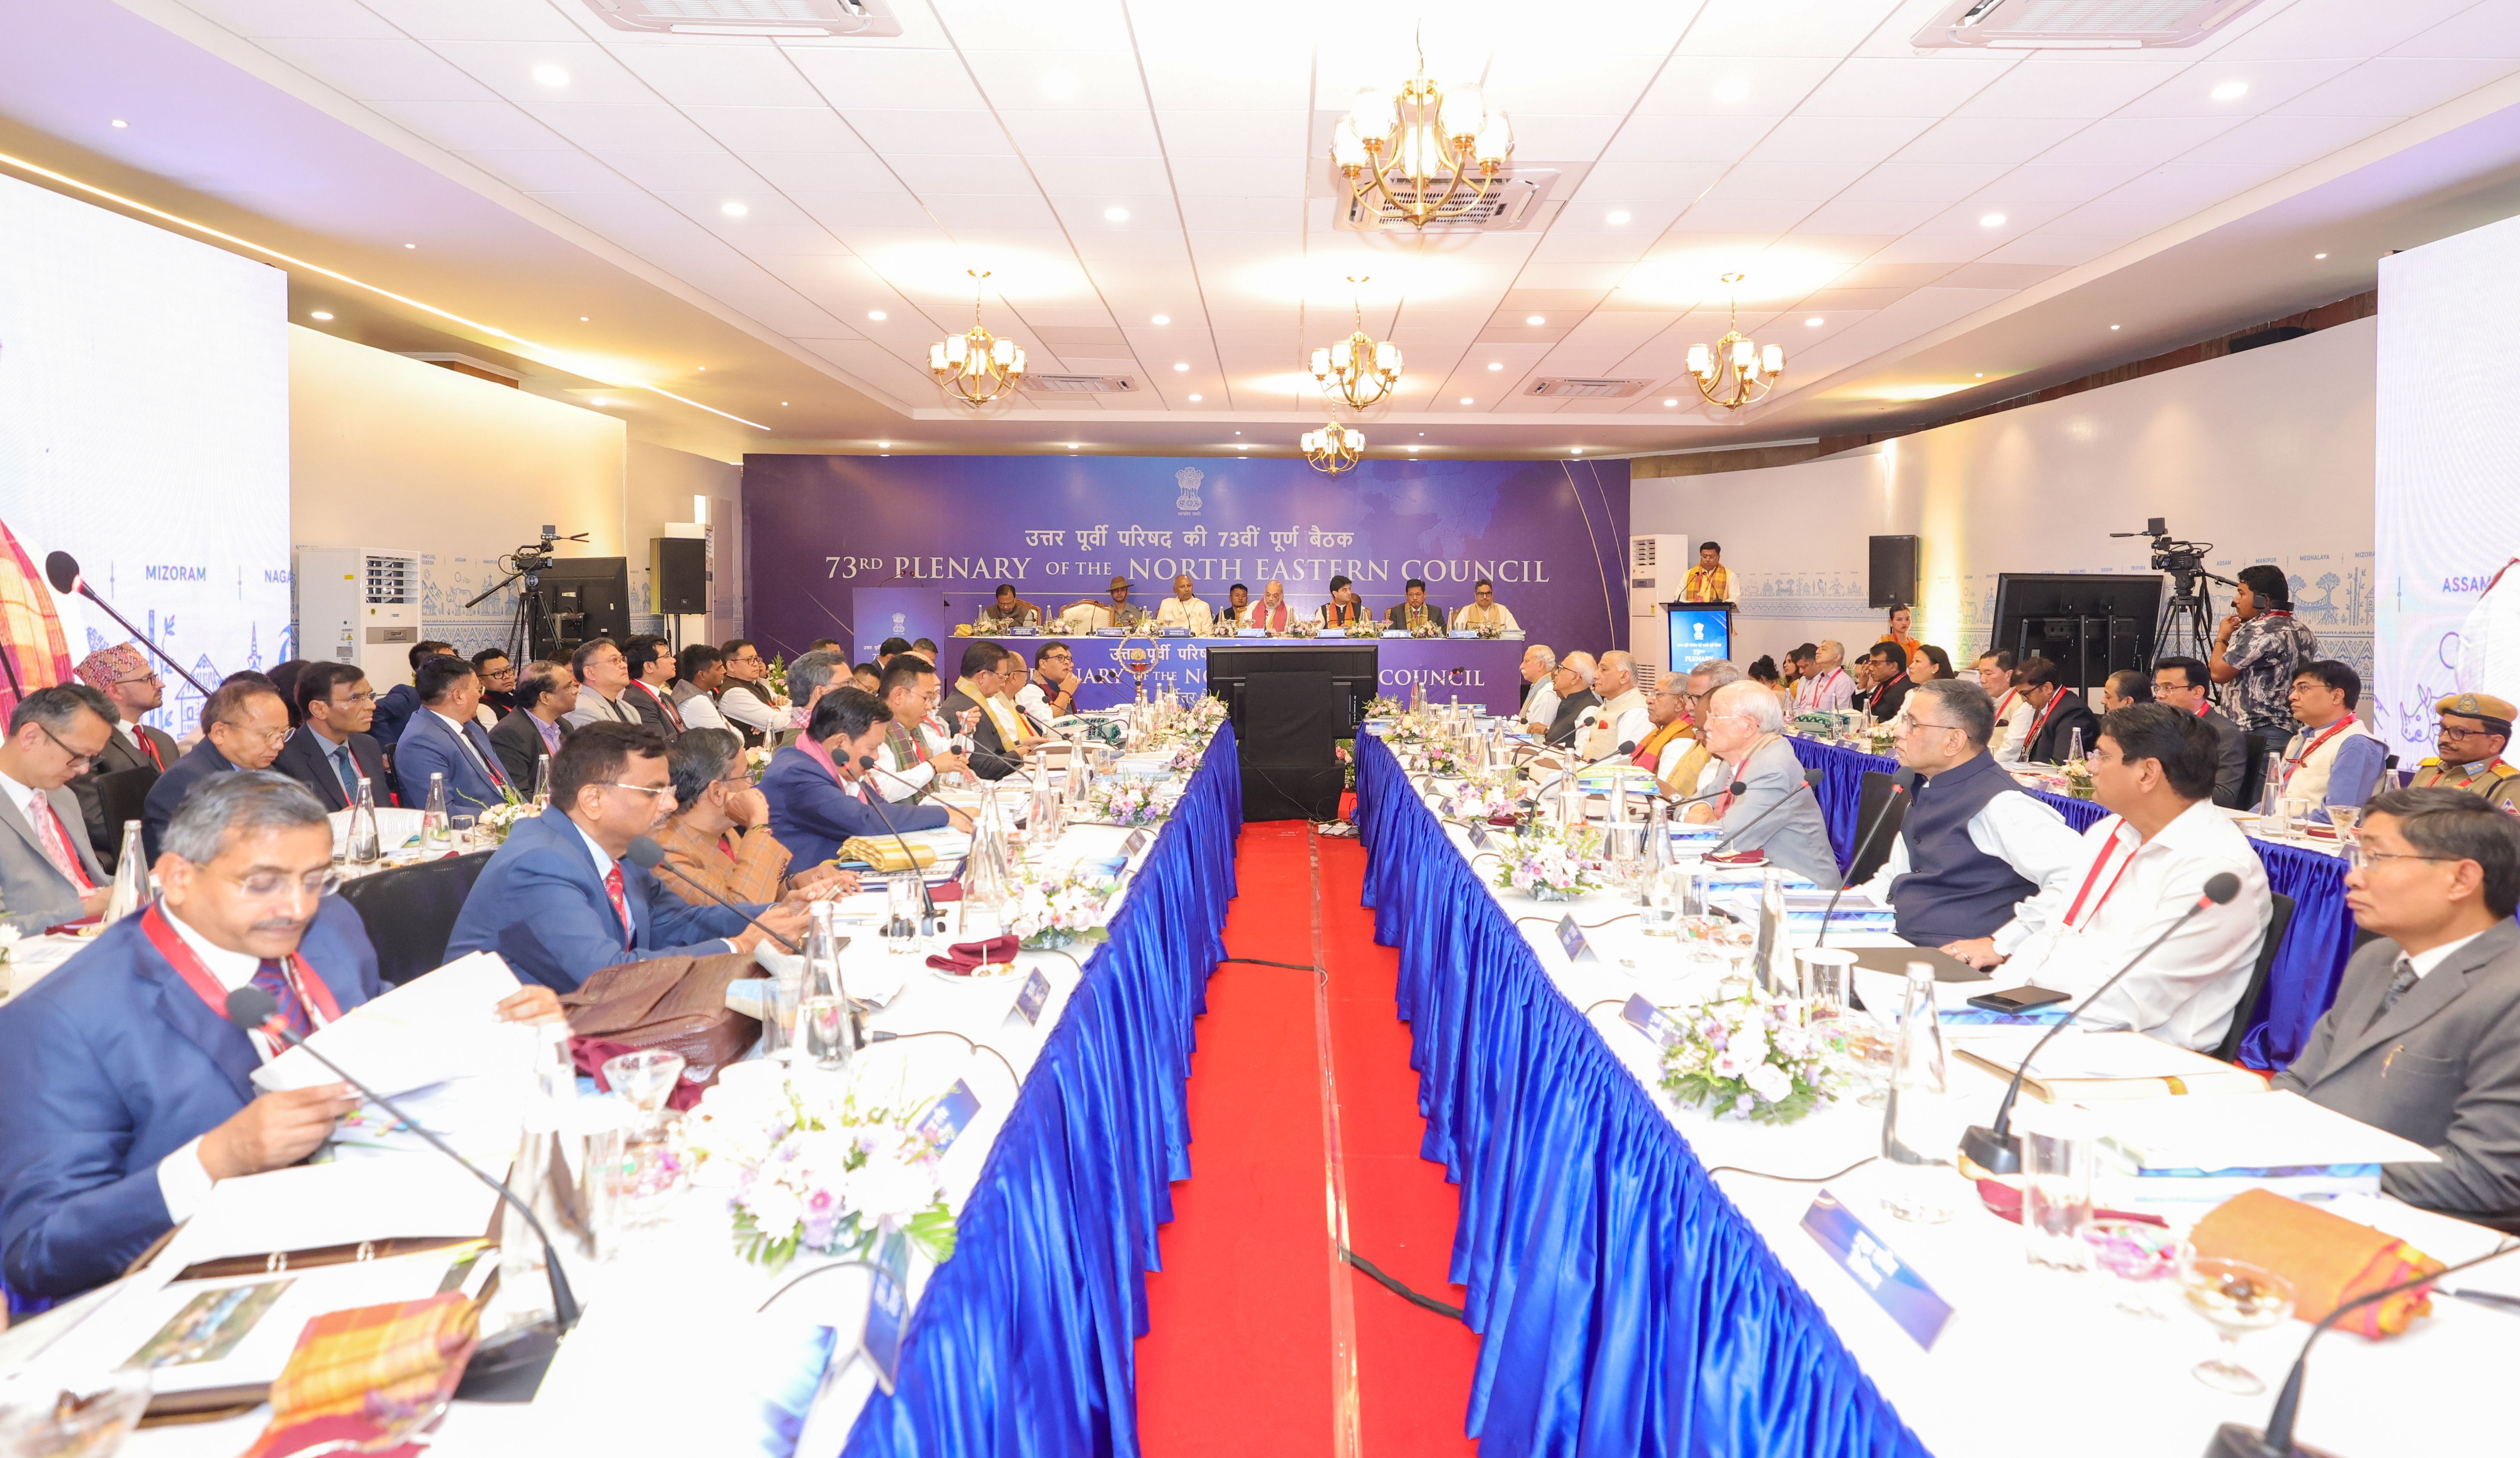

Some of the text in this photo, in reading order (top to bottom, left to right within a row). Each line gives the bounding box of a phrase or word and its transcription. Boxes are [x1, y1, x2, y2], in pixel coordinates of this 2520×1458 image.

[1025, 524, 1354, 552] उत्तर पूर्वी परिषद की 73वीं पूर्ण बैठक
[146, 565, 206, 581] MIZORAM
[826, 556, 1549, 582] 73RD PLENARY OF THE NORTH EASTERN COUNCIL
[2442, 575, 2492, 593] ASSAM
[1177, 644, 1207, 661] परिष
[1152, 671, 1177, 681] THE
[1379, 669, 1485, 686] COUNCIL
